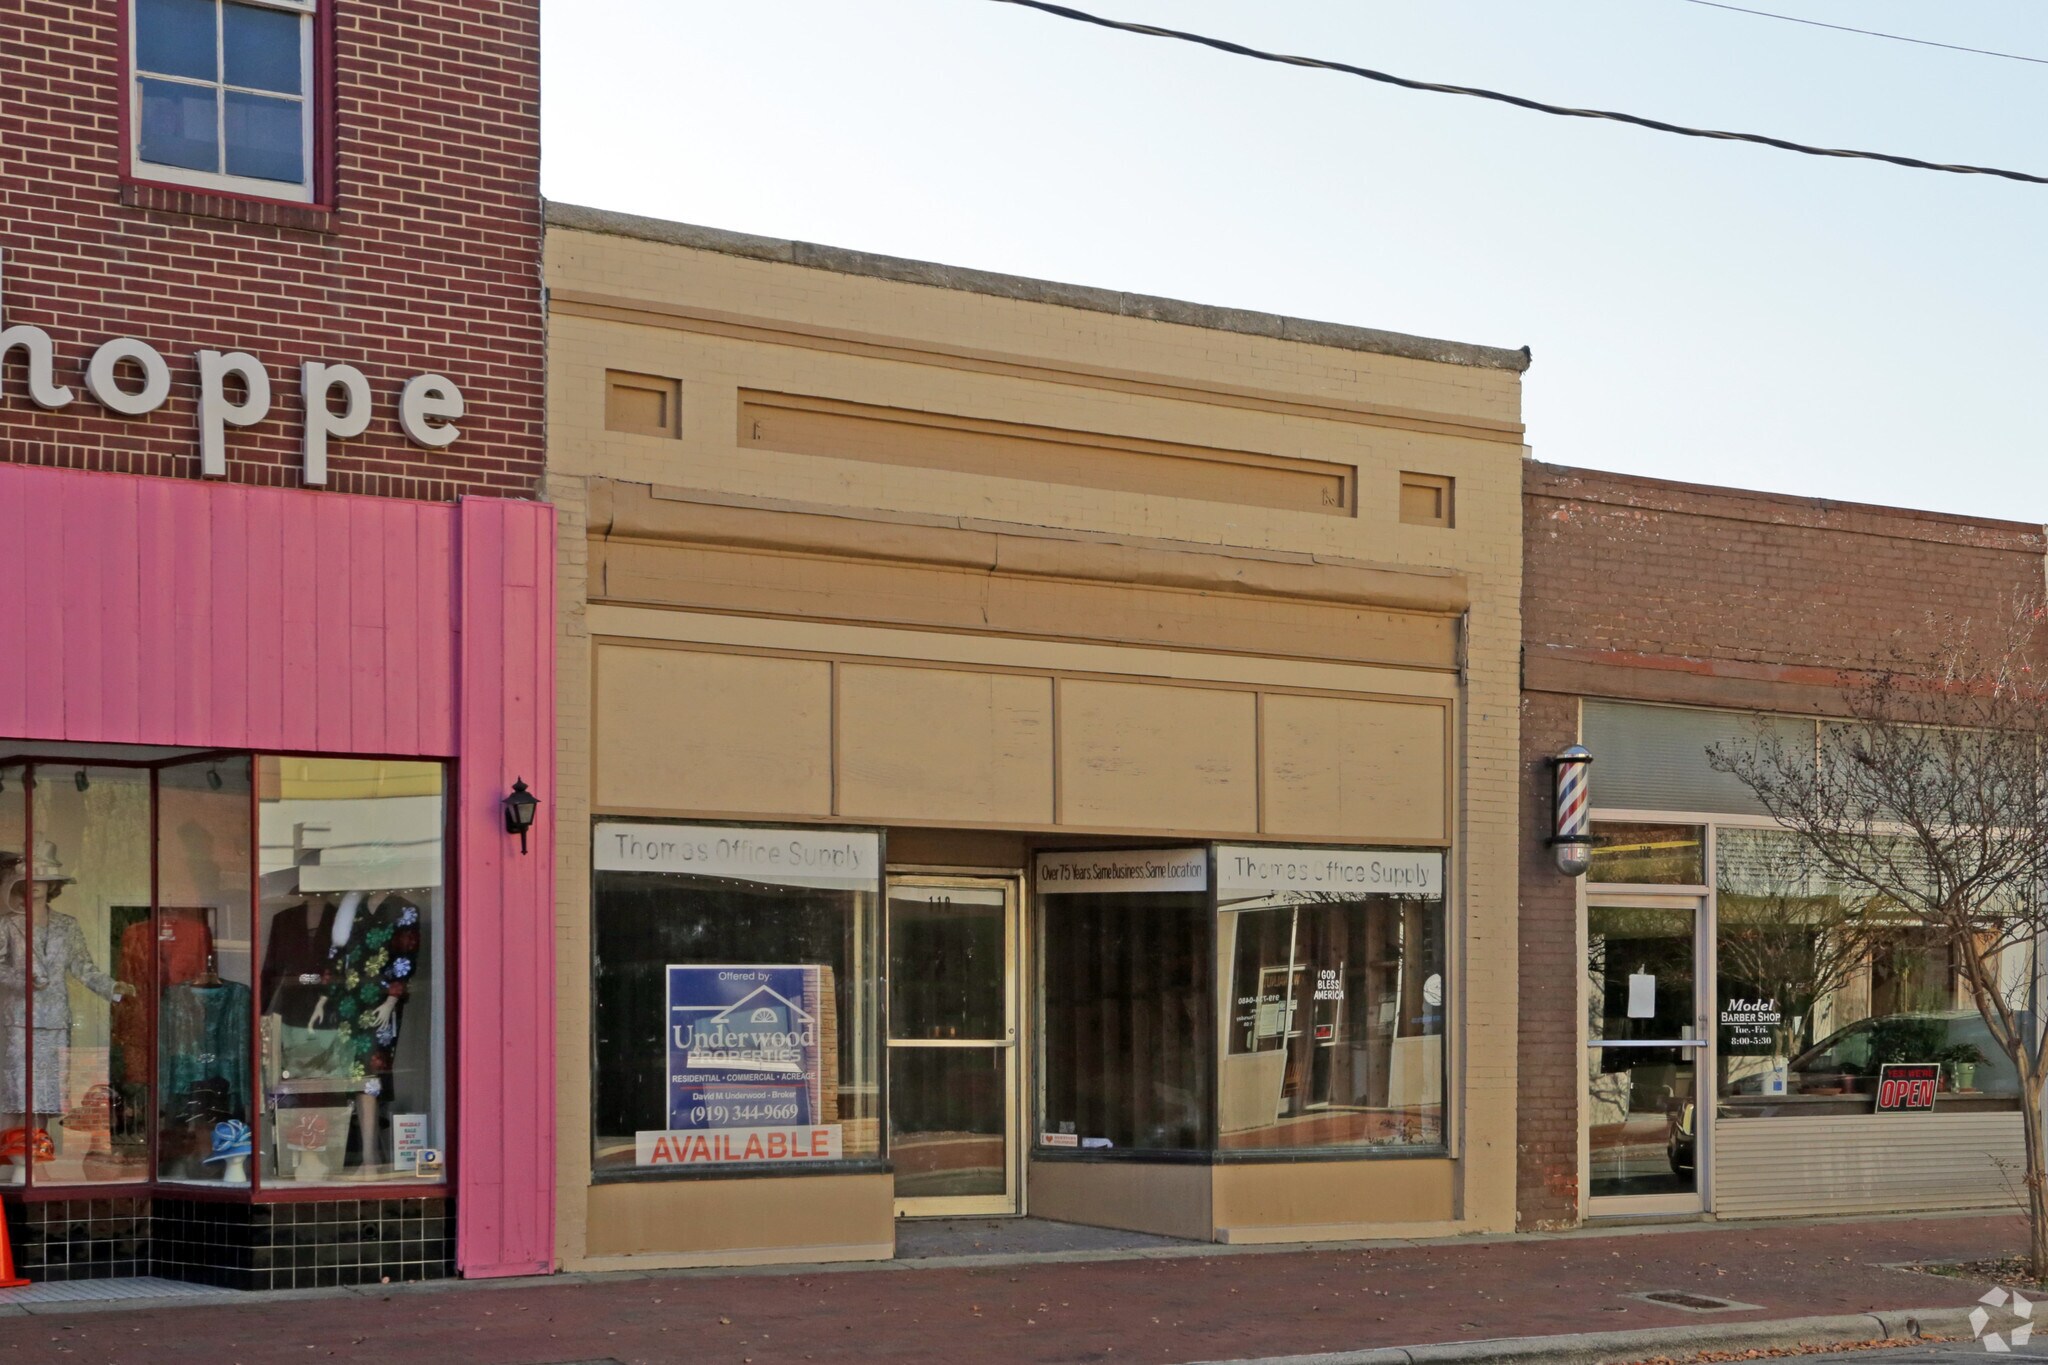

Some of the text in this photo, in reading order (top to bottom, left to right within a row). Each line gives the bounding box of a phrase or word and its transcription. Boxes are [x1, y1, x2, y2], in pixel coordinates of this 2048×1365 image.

[1041, 864, 1059, 881] Over
[1059, 863, 1071, 881] 75
[1092, 862, 1111, 880] Same
[1145, 860, 1166, 879] Same
[1167, 860, 1202, 879] Location
[1370, 860, 1430, 888] Supply
[718, 971, 773, 983] Offered by:
[1320, 970, 1336, 980] GOD
[1316, 980, 1340, 990] BLESS
[1313, 990, 1345, 1000] AMERICA
[1727, 998, 1775, 1012] Model
[1721, 1011, 1781, 1022] BARBER SHOP
[672, 1022, 815, 1050] Underwood
[1730, 1036, 1772, 1046] 8:00-5:30
[687, 1049, 802, 1065] PROPERTIES
[671, 1071, 817, 1084] RESIDENTIAL COMMERCIAL ACREAGE
[692, 1092, 714, 1101] David
[725, 1091, 766, 1100] Underwood
[771, 1090, 797, 1099] Broker
[1879, 1079, 1936, 1108] OPEN
[690, 1104, 799, 1125] (919) 344-9669
[651, 1130, 830, 1164] AVAILABLE
